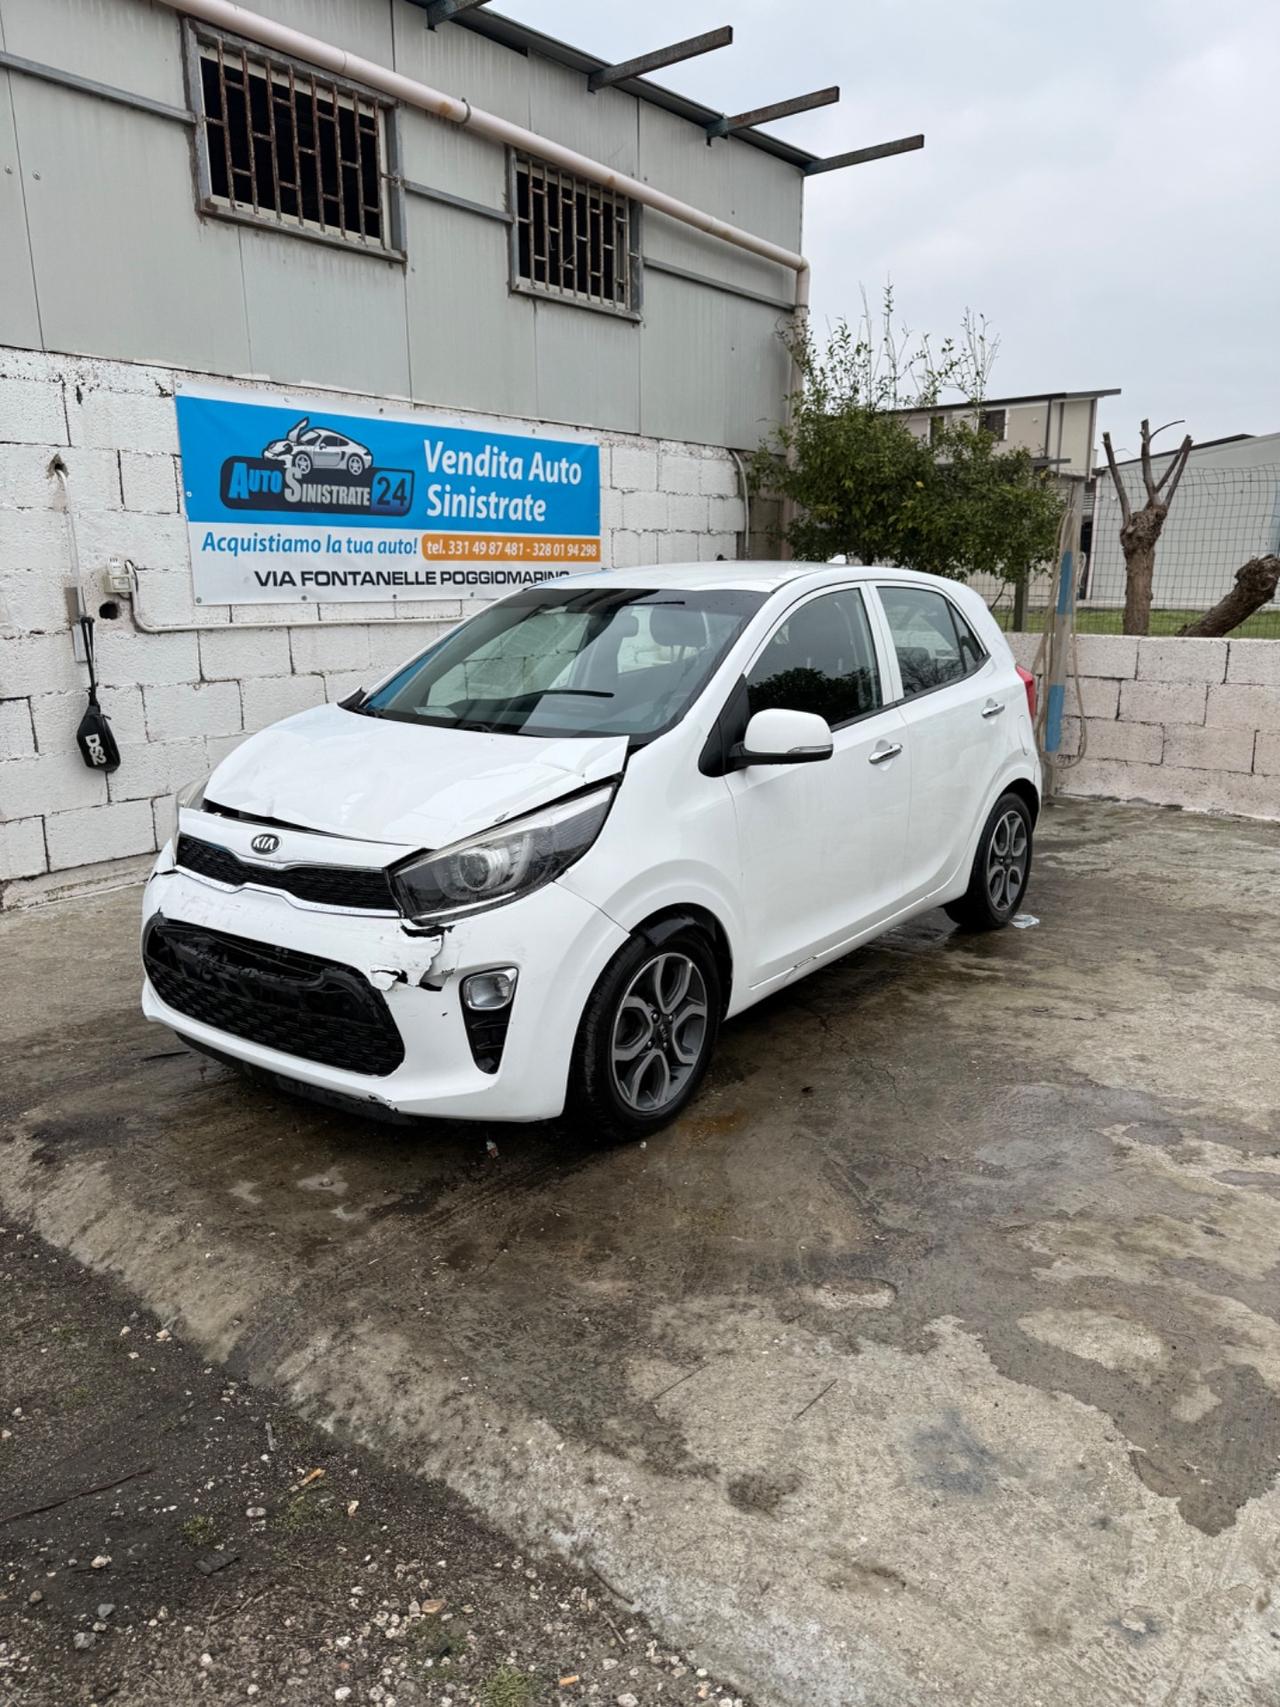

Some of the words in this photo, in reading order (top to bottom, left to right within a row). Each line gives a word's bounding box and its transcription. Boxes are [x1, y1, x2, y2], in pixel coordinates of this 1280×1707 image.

[423, 439, 523, 480] Vendita
[528, 452, 582, 485] Auto
[227, 462, 282, 499] AUTO
[377, 476, 407, 506] 24
[426, 484, 546, 521] Sinistrate
[202, 531, 321, 557] Acquistiamo
[326, 534, 341, 553] la
[346, 537, 374, 554] tua
[377, 537, 418, 555] auto!
[426, 539, 446, 554] tel.
[449, 540, 469, 555] 331
[472, 541, 486, 555] 49
[488, 541, 502, 556] 87
[505, 542, 523, 556] 481
[532, 543, 551, 556] 328
[553, 543, 565, 556] 01
[567, 543, 579, 557] 94
[580, 544, 597, 557] 298
[254, 571, 297, 587] VIA
[301, 571, 437, 587] FONTANELLE
[85, 733, 107, 765] DS2
[253, 835, 276, 850] KIA
